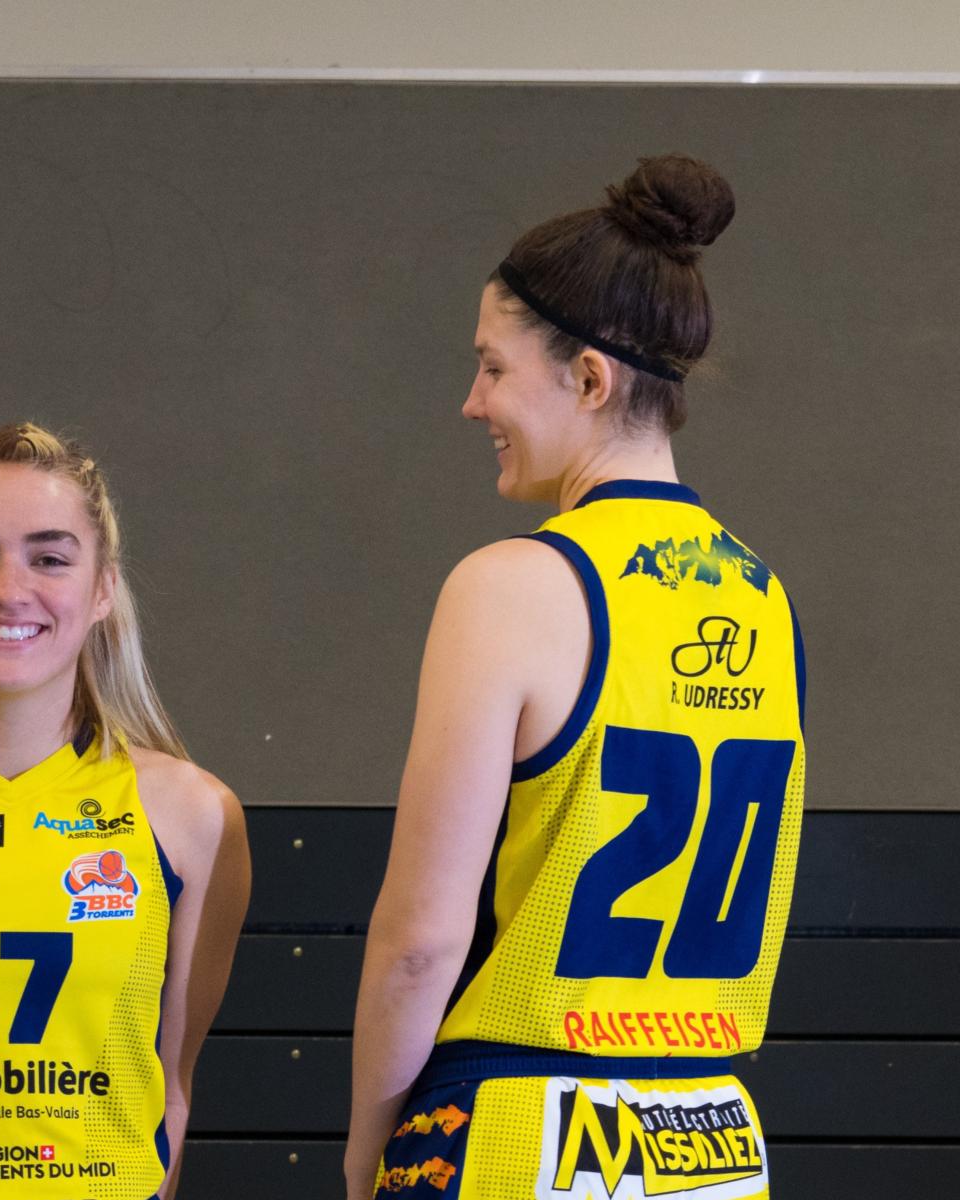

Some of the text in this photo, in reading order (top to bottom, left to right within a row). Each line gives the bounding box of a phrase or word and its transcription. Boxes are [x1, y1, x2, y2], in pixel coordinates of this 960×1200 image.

[684, 684, 765, 710] UDRESSY
[554, 724, 797, 979] 20
[69, 901, 87, 921] 3
[74, 894, 134, 910] BBC
[87, 910, 134, 919] TORRENTS
[564, 1011, 741, 1049] RAIFFEISEN
[16, 1105, 80, 1120] Bas-Valais
[49, 1163, 74, 1178] DU
[79, 1162, 116, 1177] MIDI
